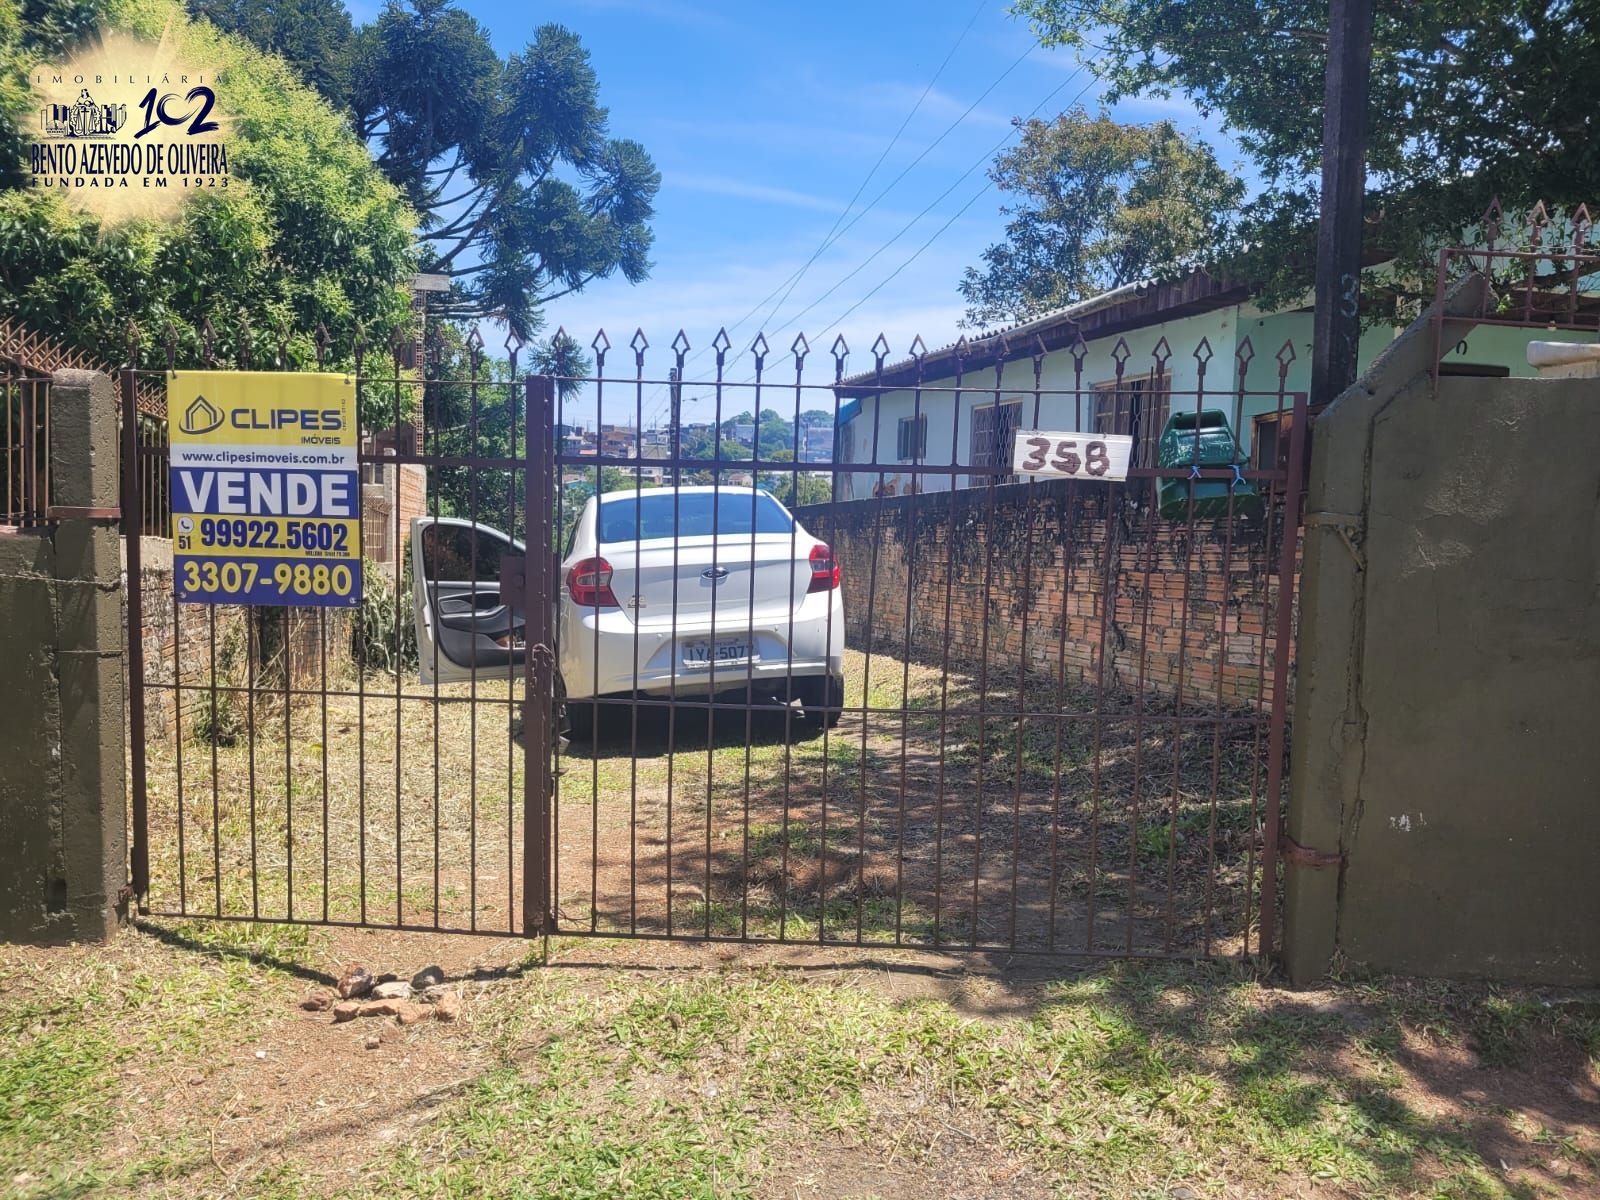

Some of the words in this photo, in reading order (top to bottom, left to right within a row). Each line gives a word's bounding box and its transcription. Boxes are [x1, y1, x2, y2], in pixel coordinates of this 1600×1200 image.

[230, 408, 342, 431] CLIPES
[301, 433, 341, 446] IMÓVEIS
[182, 451, 345, 466] www.clipesimoveis.com.br
[1022, 437, 1110, 477] 358
[179, 471, 350, 516] VENDE
[178, 535, 192, 550] 51
[200, 518, 348, 552] 99922.5602
[183, 561, 352, 596] 3307-9880
